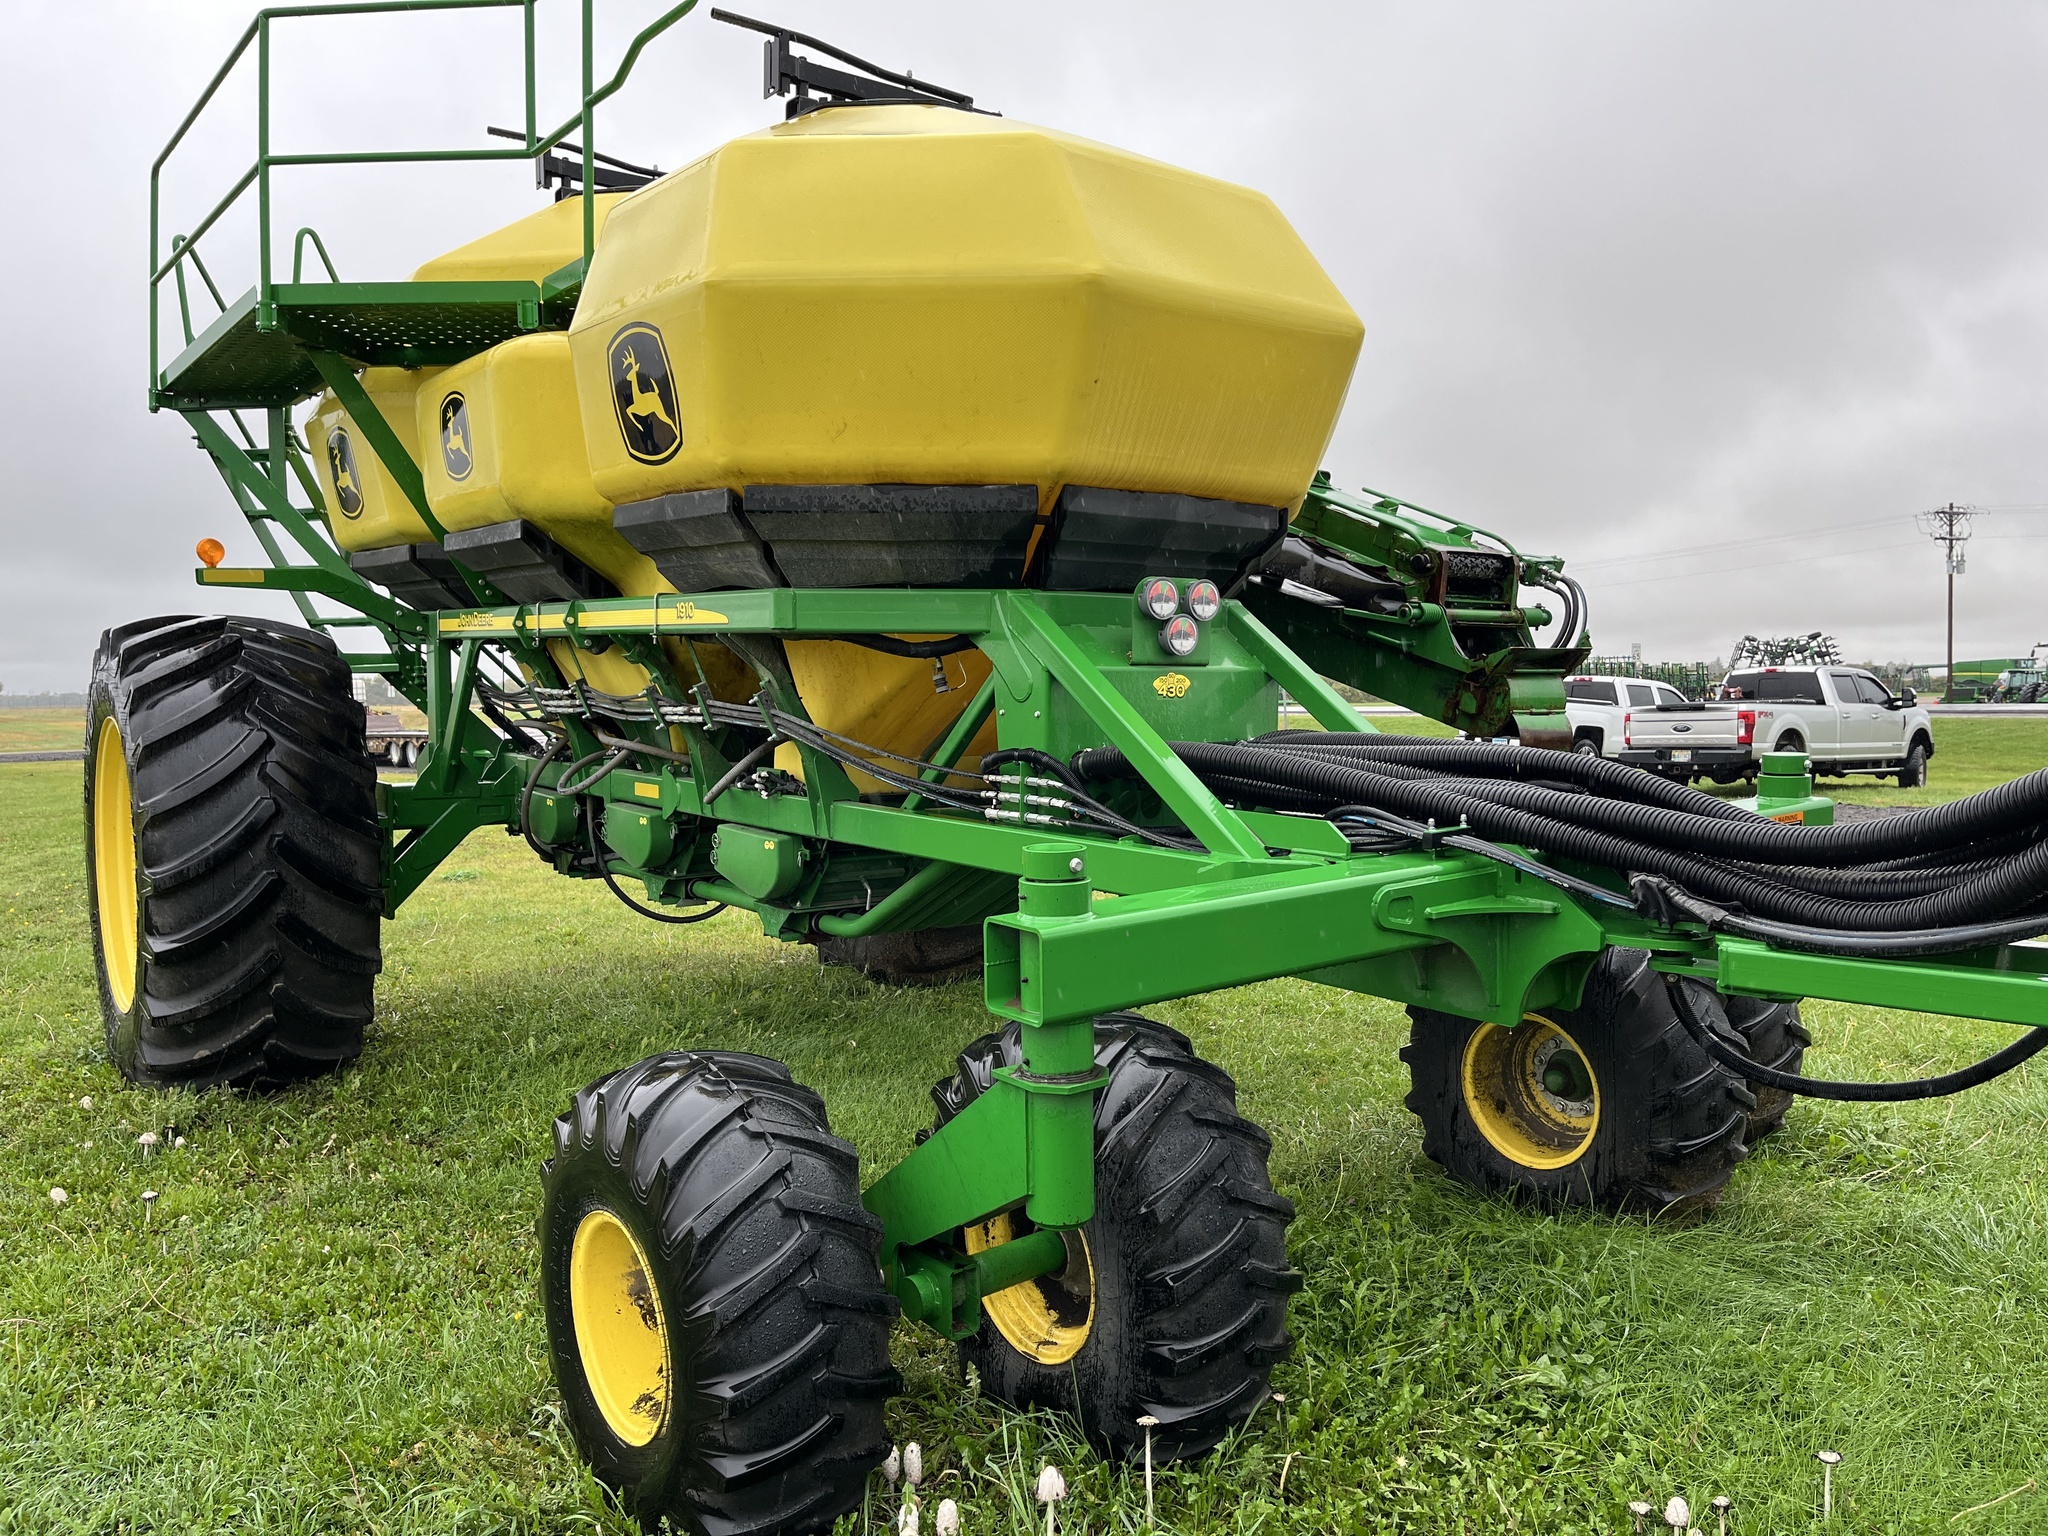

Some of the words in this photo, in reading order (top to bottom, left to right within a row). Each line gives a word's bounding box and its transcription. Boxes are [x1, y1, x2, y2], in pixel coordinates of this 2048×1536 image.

[676, 601, 695, 619] 1910
[474, 611, 494, 626] DEERE
[1632, 652, 1641, 661] 65
[1157, 683, 1186, 699] 430
